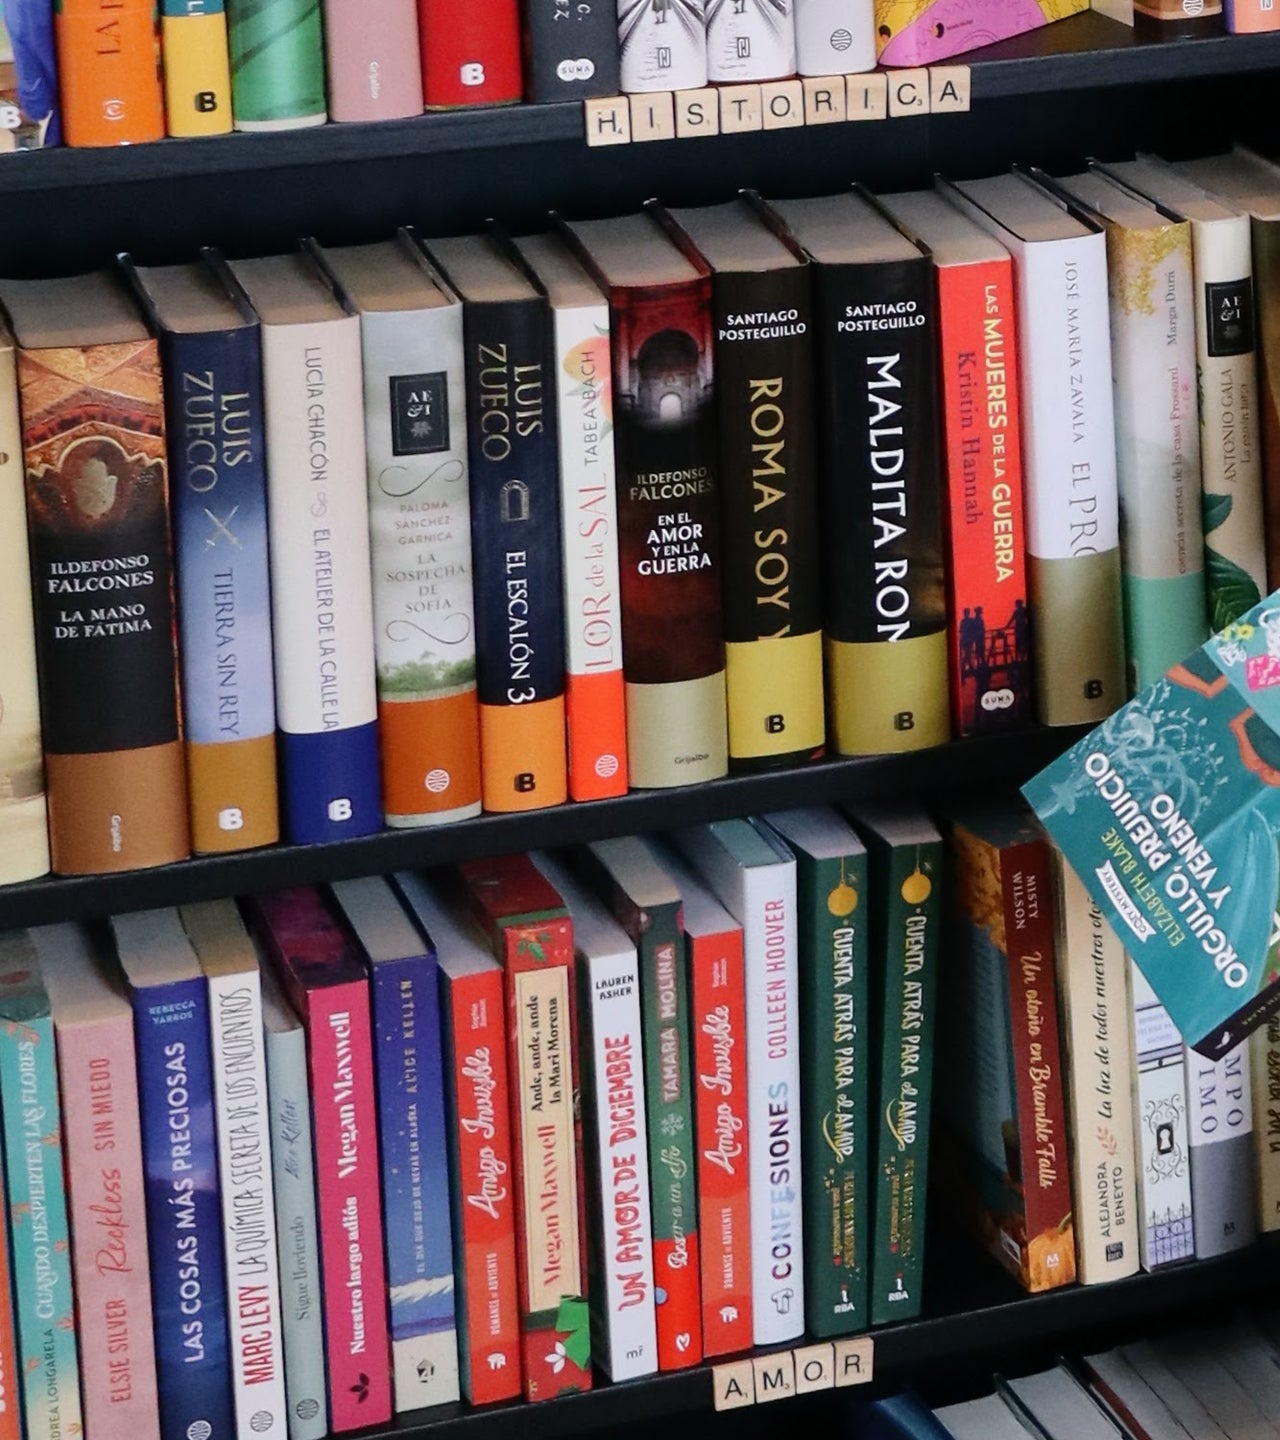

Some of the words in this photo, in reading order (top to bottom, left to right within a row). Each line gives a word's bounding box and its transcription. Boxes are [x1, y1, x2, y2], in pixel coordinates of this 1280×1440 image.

[837, 315, 925, 333] POSTEGUILLO
[845, 301, 917, 318] SANTIAGO
[985, 285, 997, 313] LAS
[986, 319, 1009, 429] MUJERES
[183, 371, 217, 494] ZUECO
[219, 391, 253, 467] LUIS
[867, 352, 909, 549] MALDITA
[992, 435, 1005, 453] DE
[994, 459, 1006, 479] LA
[993, 484, 1014, 583] GUERRA
[48, 571, 154, 594] FALCONES
[50, 555, 149, 576] ILDEFONSO
[55, 624, 79, 639] DE
[60, 607, 85, 624] LA
[90, 603, 146, 623] MANO
[1085, 752, 1172, 872] PREJUICIO
[1101, 827, 1137, 874] BLAKE
[1151, 794, 1218, 892] VENENO
[1130, 872, 1186, 949] ELIZABETH
[1207, 884, 1232, 909] Y
[765, 898, 785, 972] HOOVER
[768, 980, 788, 1060] COLLEEN
[165, 1042, 193, 1171] PRECIOSAS
[610, 1152, 636, 1182] DE
[770, 1079, 794, 1281] CONFESIONES
[168, 1176, 197, 1229] MÁS
[613, 1185, 641, 1267] AMOR
[178, 1238, 201, 1310] COSAS
[618, 1272, 646, 1313] UN
[182, 1321, 204, 1363] LAS
[723, 1352, 866, 1401] AMOR
